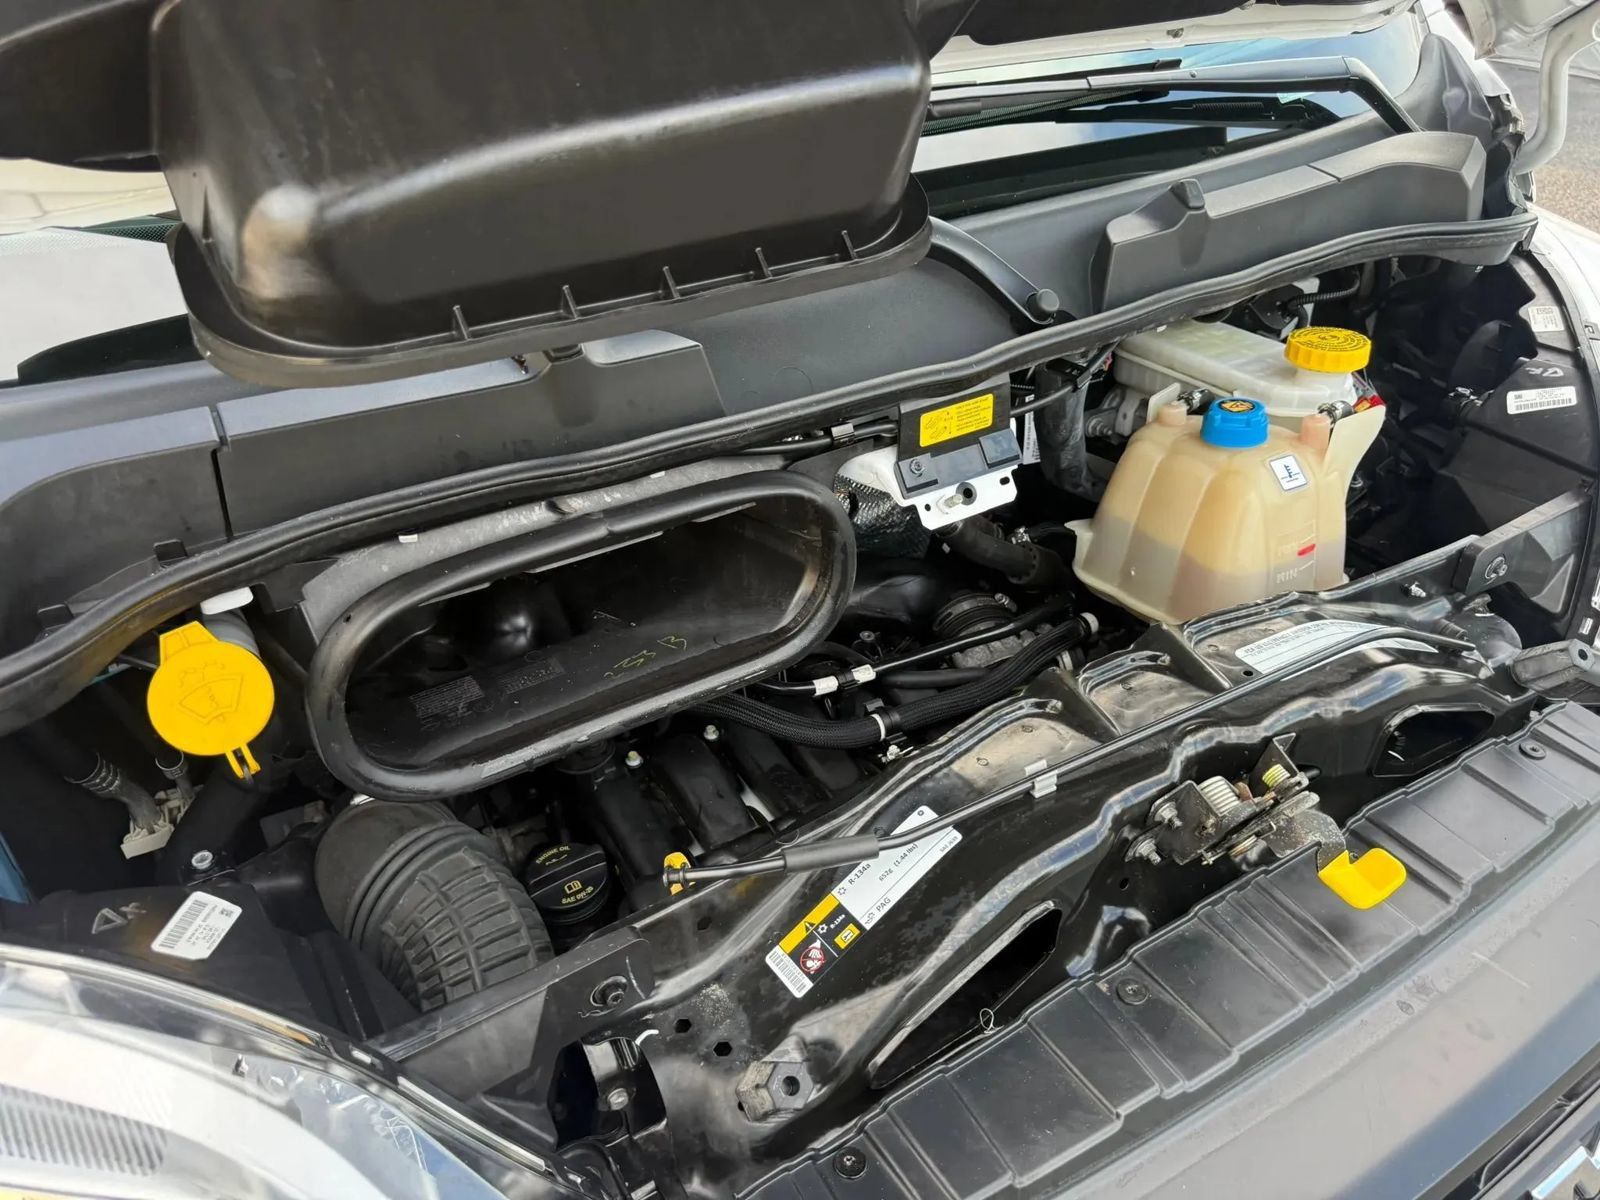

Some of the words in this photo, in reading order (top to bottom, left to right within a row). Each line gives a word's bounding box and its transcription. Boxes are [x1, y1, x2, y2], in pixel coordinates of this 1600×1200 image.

[535, 848, 558, 864] ENGINE
[848, 863, 871, 885] R-134a
[561, 896, 576, 904] SAE
[876, 896, 891, 912] PAG
